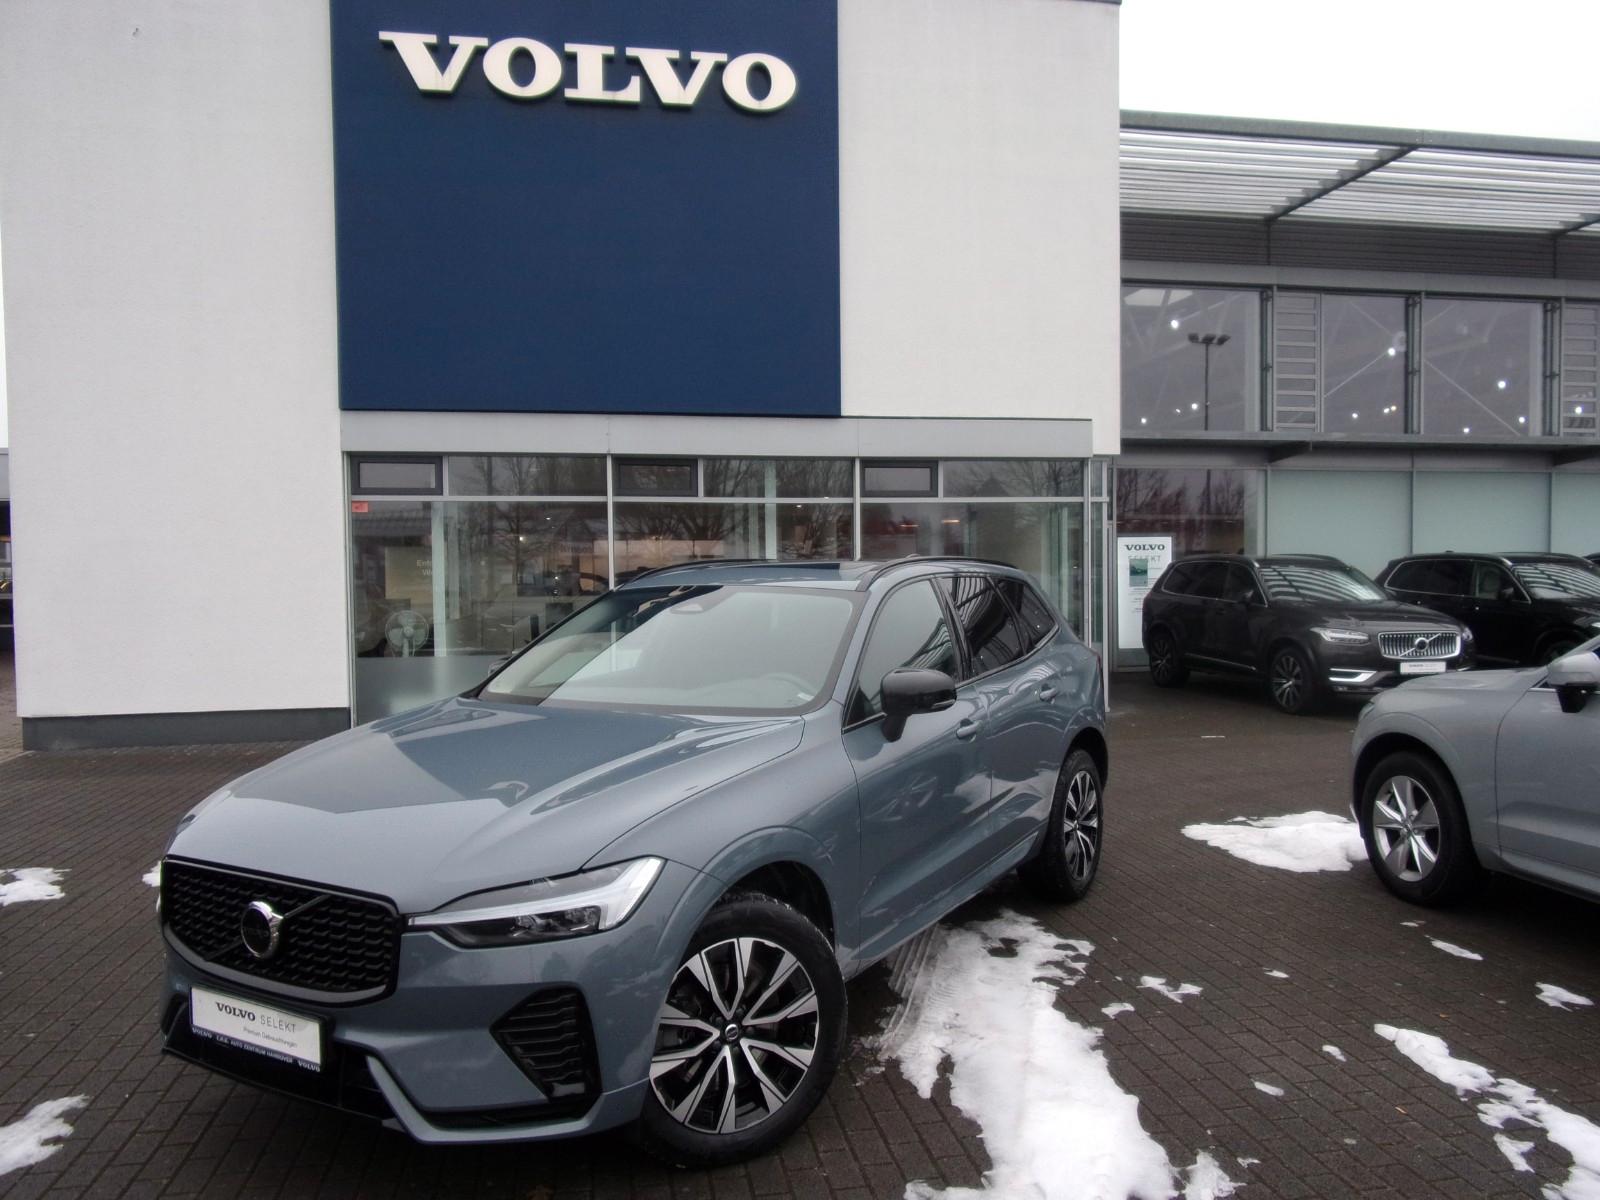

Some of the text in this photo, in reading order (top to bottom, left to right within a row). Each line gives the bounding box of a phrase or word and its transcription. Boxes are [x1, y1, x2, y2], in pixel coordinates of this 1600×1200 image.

[379, 31, 796, 112] VOLVO
[216, 1002, 296, 1033] VOLVO SELEKT
[298, 1060, 321, 1073] VOLVO
